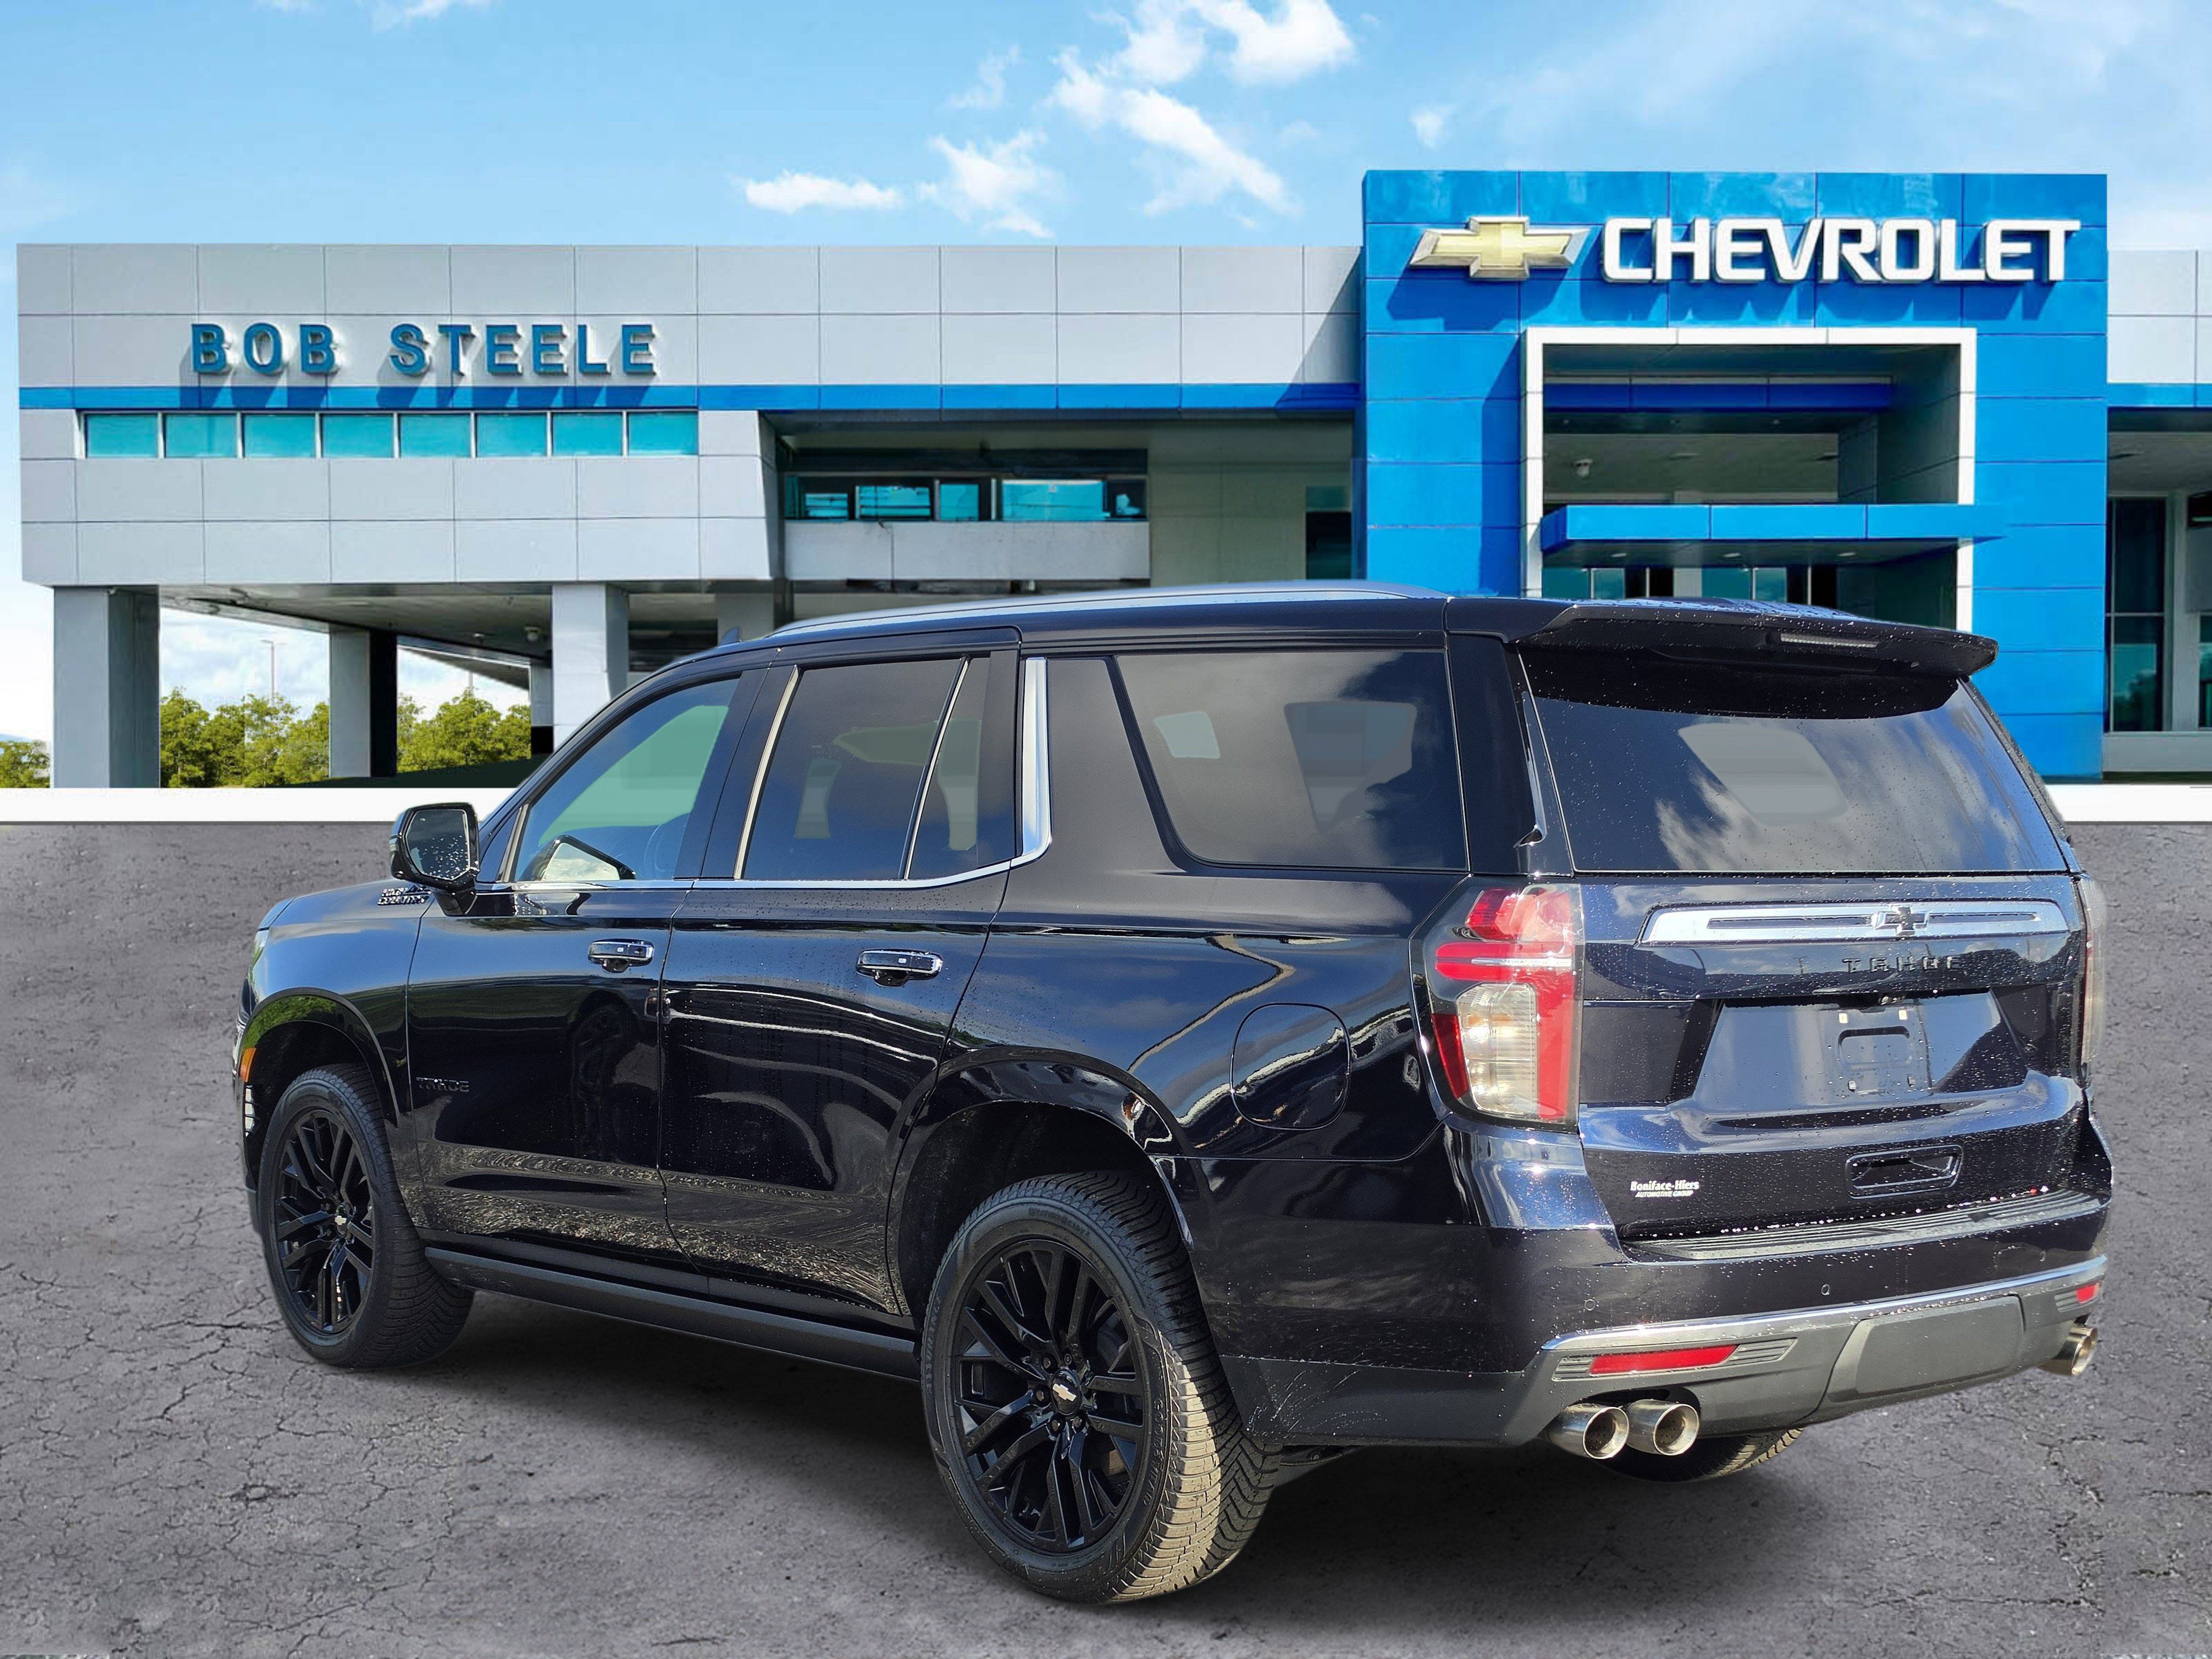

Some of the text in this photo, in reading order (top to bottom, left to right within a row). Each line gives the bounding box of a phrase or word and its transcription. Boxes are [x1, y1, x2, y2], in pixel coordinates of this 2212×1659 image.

[1602, 217, 2081, 283] CHEVROLET
[191, 323, 658, 376] BOB STEELE
[1842, 956, 1964, 973] TAHOE
[416, 1077, 470, 1093] TAHOE
[1630, 1179, 1700, 1191] Boniface-Hiers
